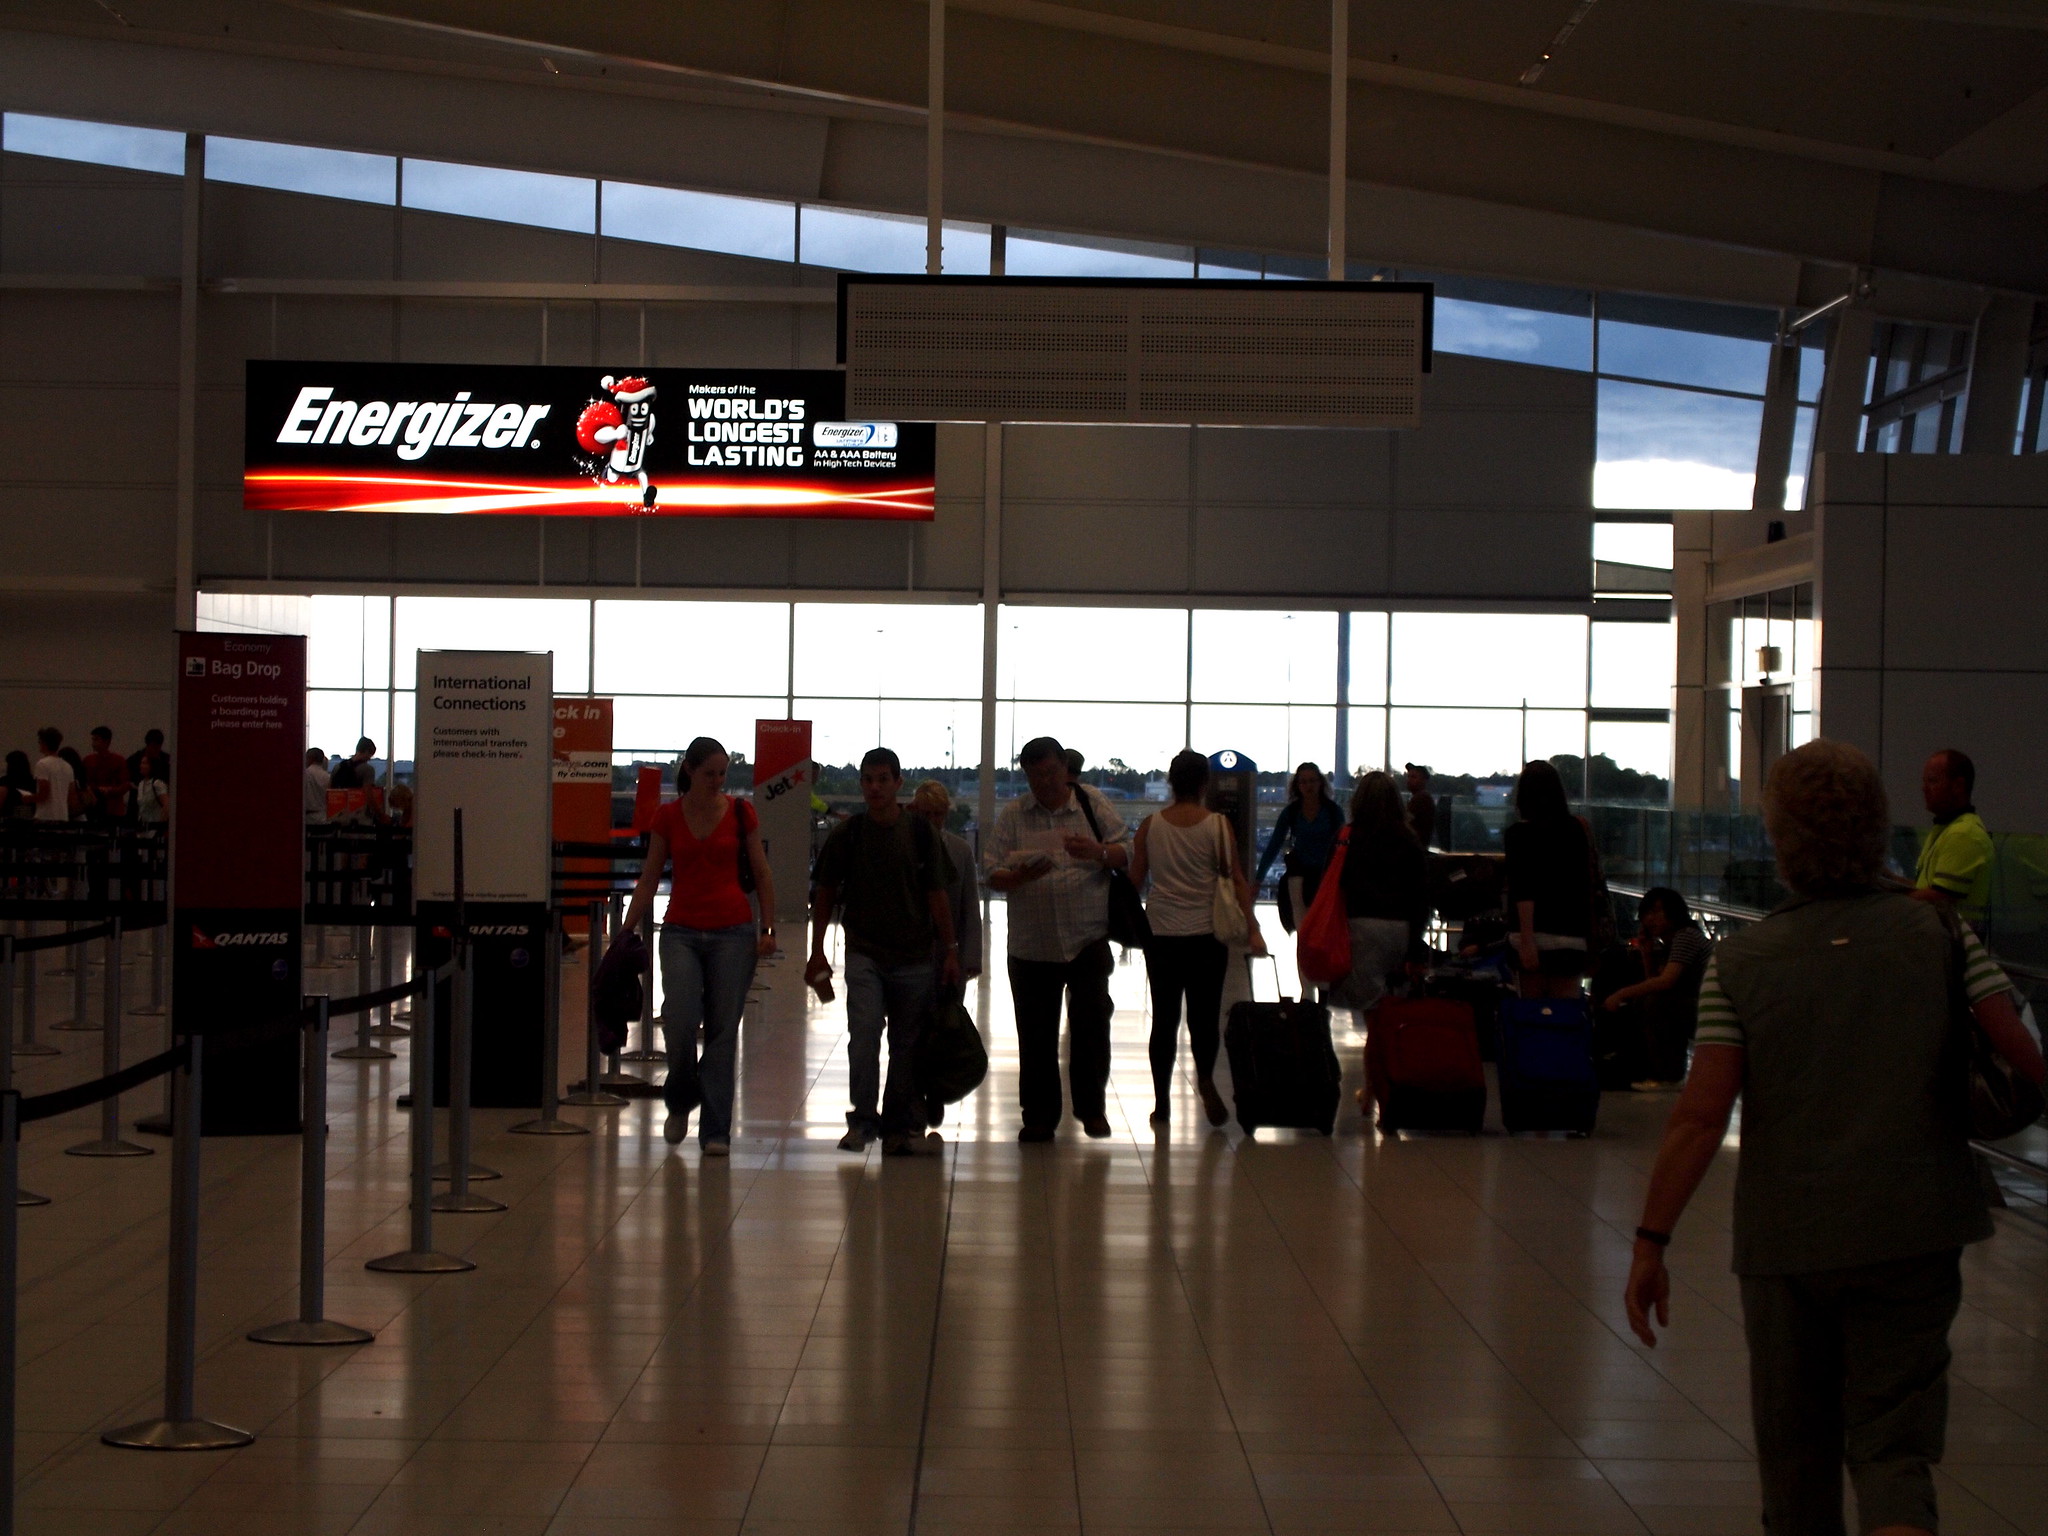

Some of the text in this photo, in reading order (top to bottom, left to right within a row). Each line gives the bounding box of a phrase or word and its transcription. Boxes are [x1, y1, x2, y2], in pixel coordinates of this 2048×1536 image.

[689, 384, 757, 395] Makers of the
[688, 397, 805, 420] WORLD'S
[688, 421, 805, 444] LONGEST
[822, 426, 864, 438] Energizer
[688, 445, 804, 467] LASTING
[814, 449, 897, 461] AA & AAA Battery
[823, 459, 842, 468] High
[843, 460, 862, 468] Tech
[863, 460, 896, 468] Devices
[223, 640, 272, 655] Economy
[211, 659, 281, 680] Bag Drop
[433, 676, 531, 690] International
[211, 693, 288, 707] Customers holding
[433, 696, 526, 711] Connections
[210, 707, 217, 716] a
[219, 706, 259, 718] boarding
[552, 704, 601, 720] ck in
[210, 719, 240, 730] please
[242, 720, 265, 729] enter
[760, 723, 802, 734] Check-in
[433, 727, 500, 736] Customers with
[433, 738, 528, 748] international transfers
[433, 750, 460, 759] please
[461, 750, 497, 758] check-in
[570, 770, 608, 778] cheaper
[765, 777, 793, 800] Jet
[467, 924, 530, 936] ANTAS
[213, 932, 289, 947] QANTAS
